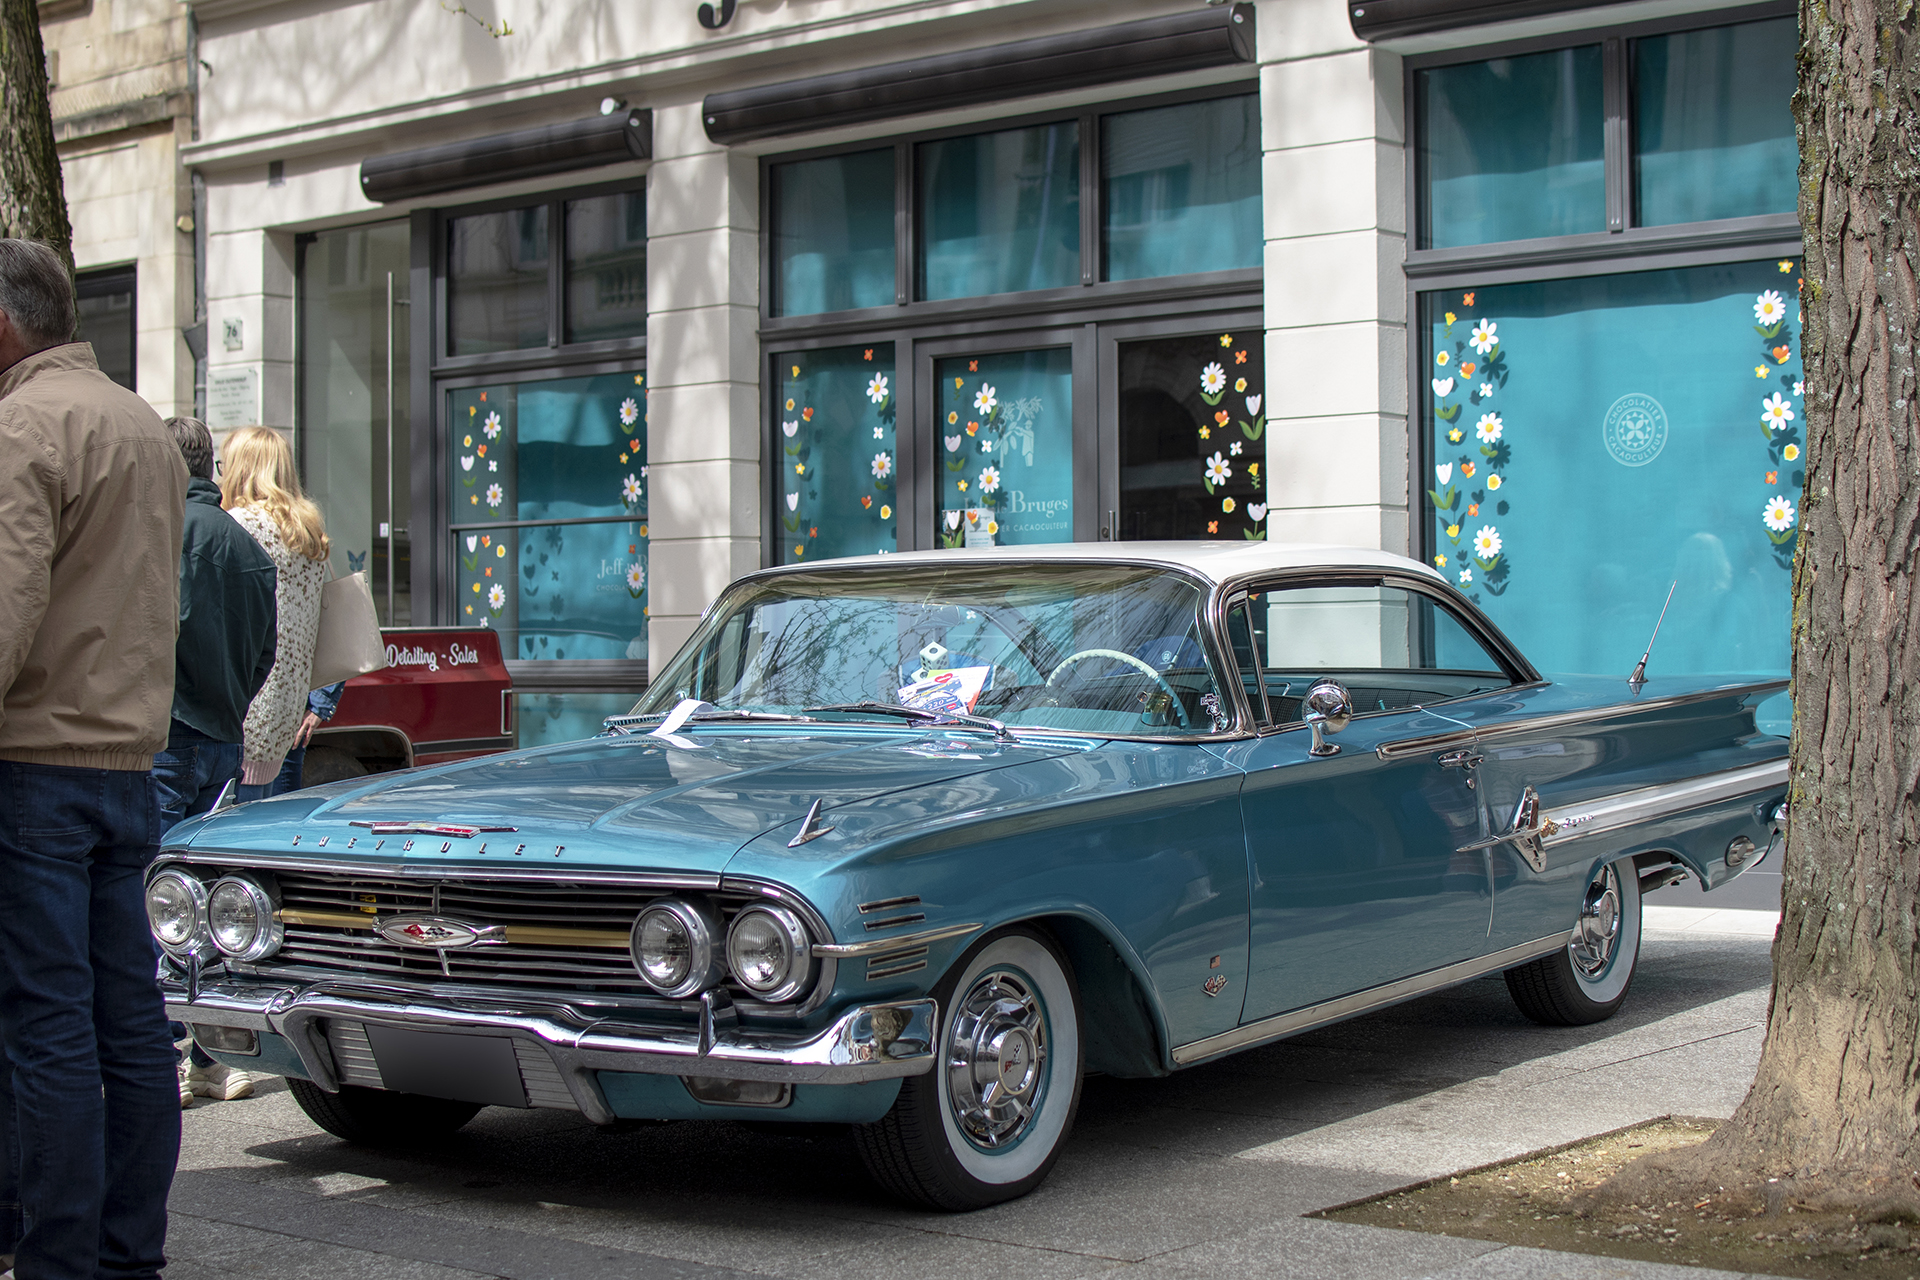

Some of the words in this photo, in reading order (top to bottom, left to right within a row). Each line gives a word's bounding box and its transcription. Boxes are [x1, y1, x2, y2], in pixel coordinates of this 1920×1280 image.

[226, 325, 238, 338] 76
[1609, 398, 1662, 425] CHOCOLATIER
[1608, 433, 1663, 461] CACAOCULTEUR
[1009, 490, 1069, 518] Bruges
[1013, 522, 1068, 532] CACAOCULTEUR
[597, 557, 623, 580] Jeff
[385, 643, 439, 672] Detailing
[449, 643, 478, 666] Sales
[292, 834, 565, 857] CHEVROLET
